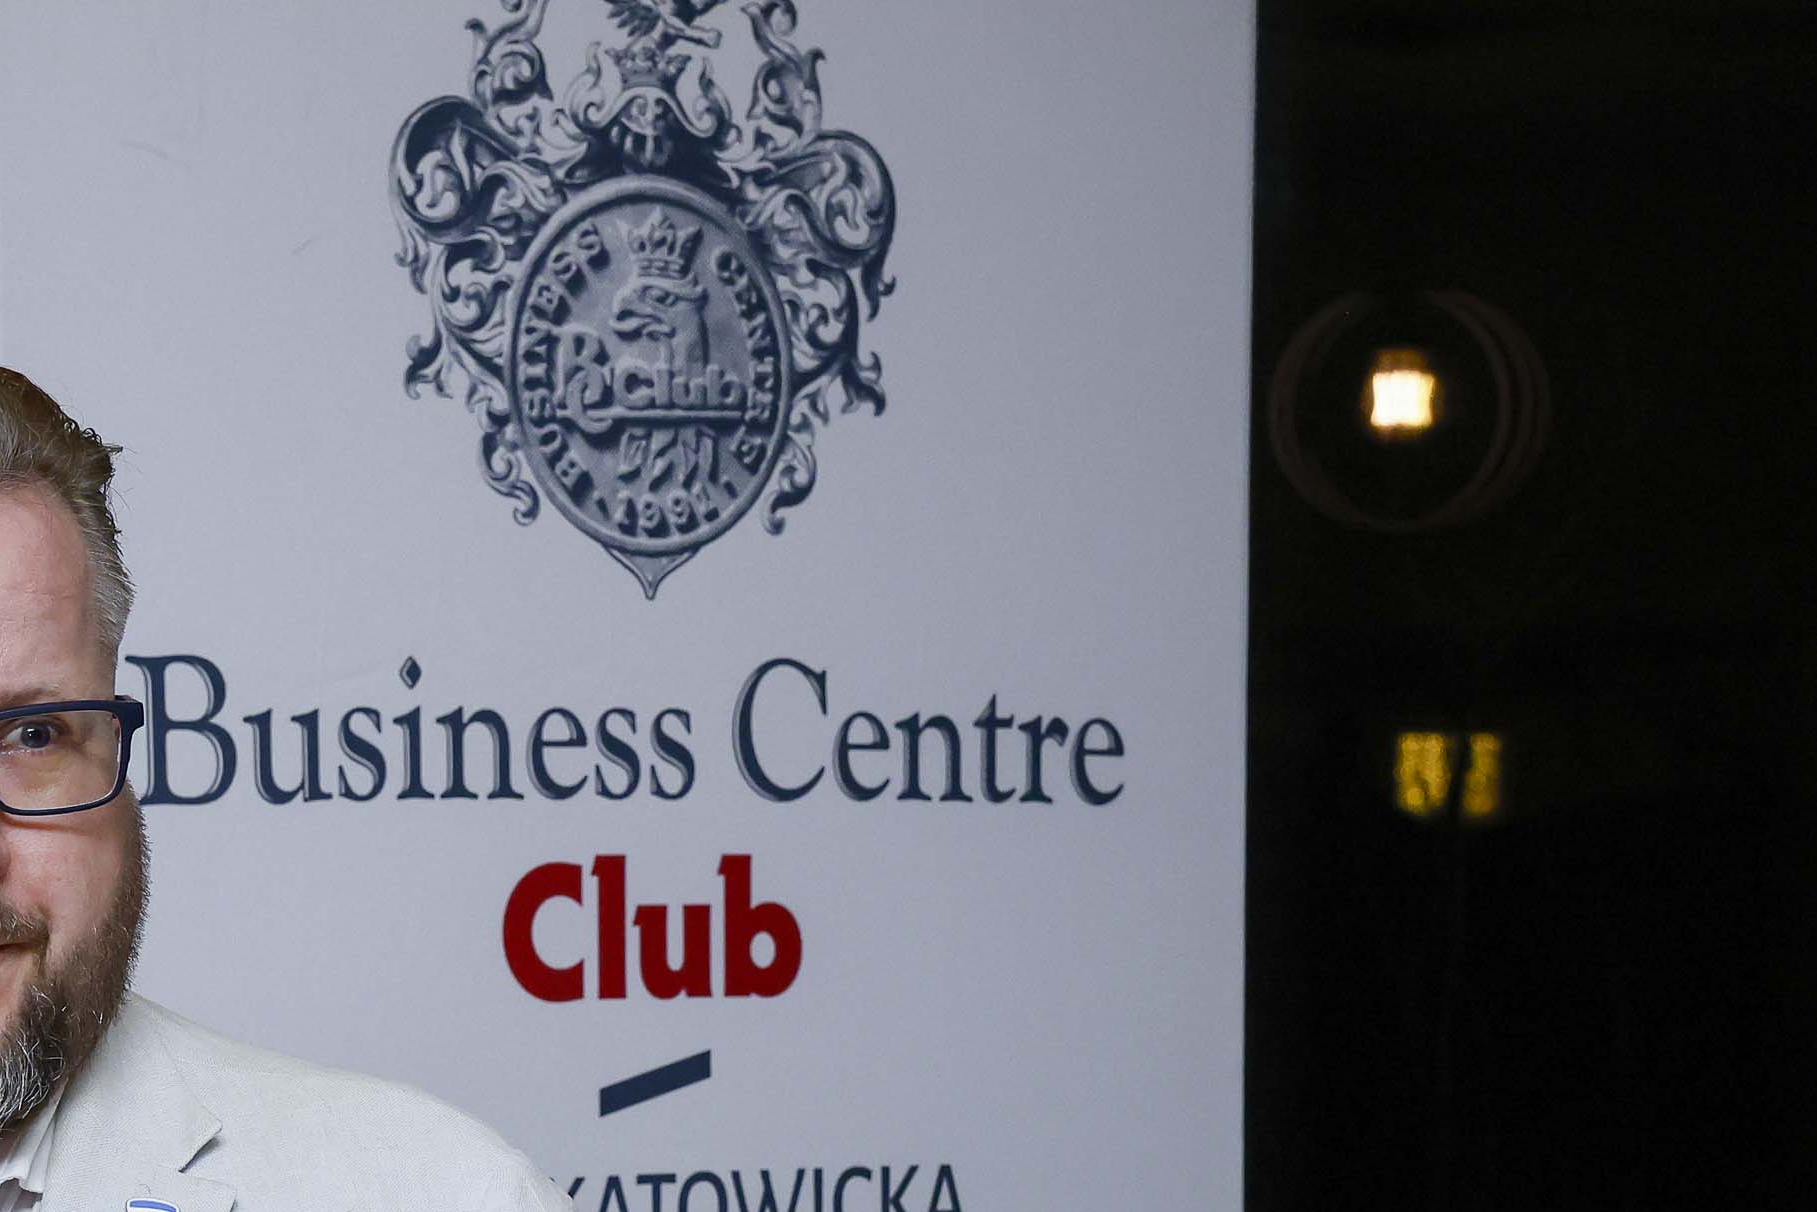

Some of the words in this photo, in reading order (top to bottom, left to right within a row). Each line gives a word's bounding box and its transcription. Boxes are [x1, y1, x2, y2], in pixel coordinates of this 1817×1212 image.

[613, 363, 747, 410] Club
[613, 485, 723, 538] 1991
[125, 653, 696, 806] Business
[731, 657, 1126, 806] Centre
[504, 854, 802, 1003] Club
